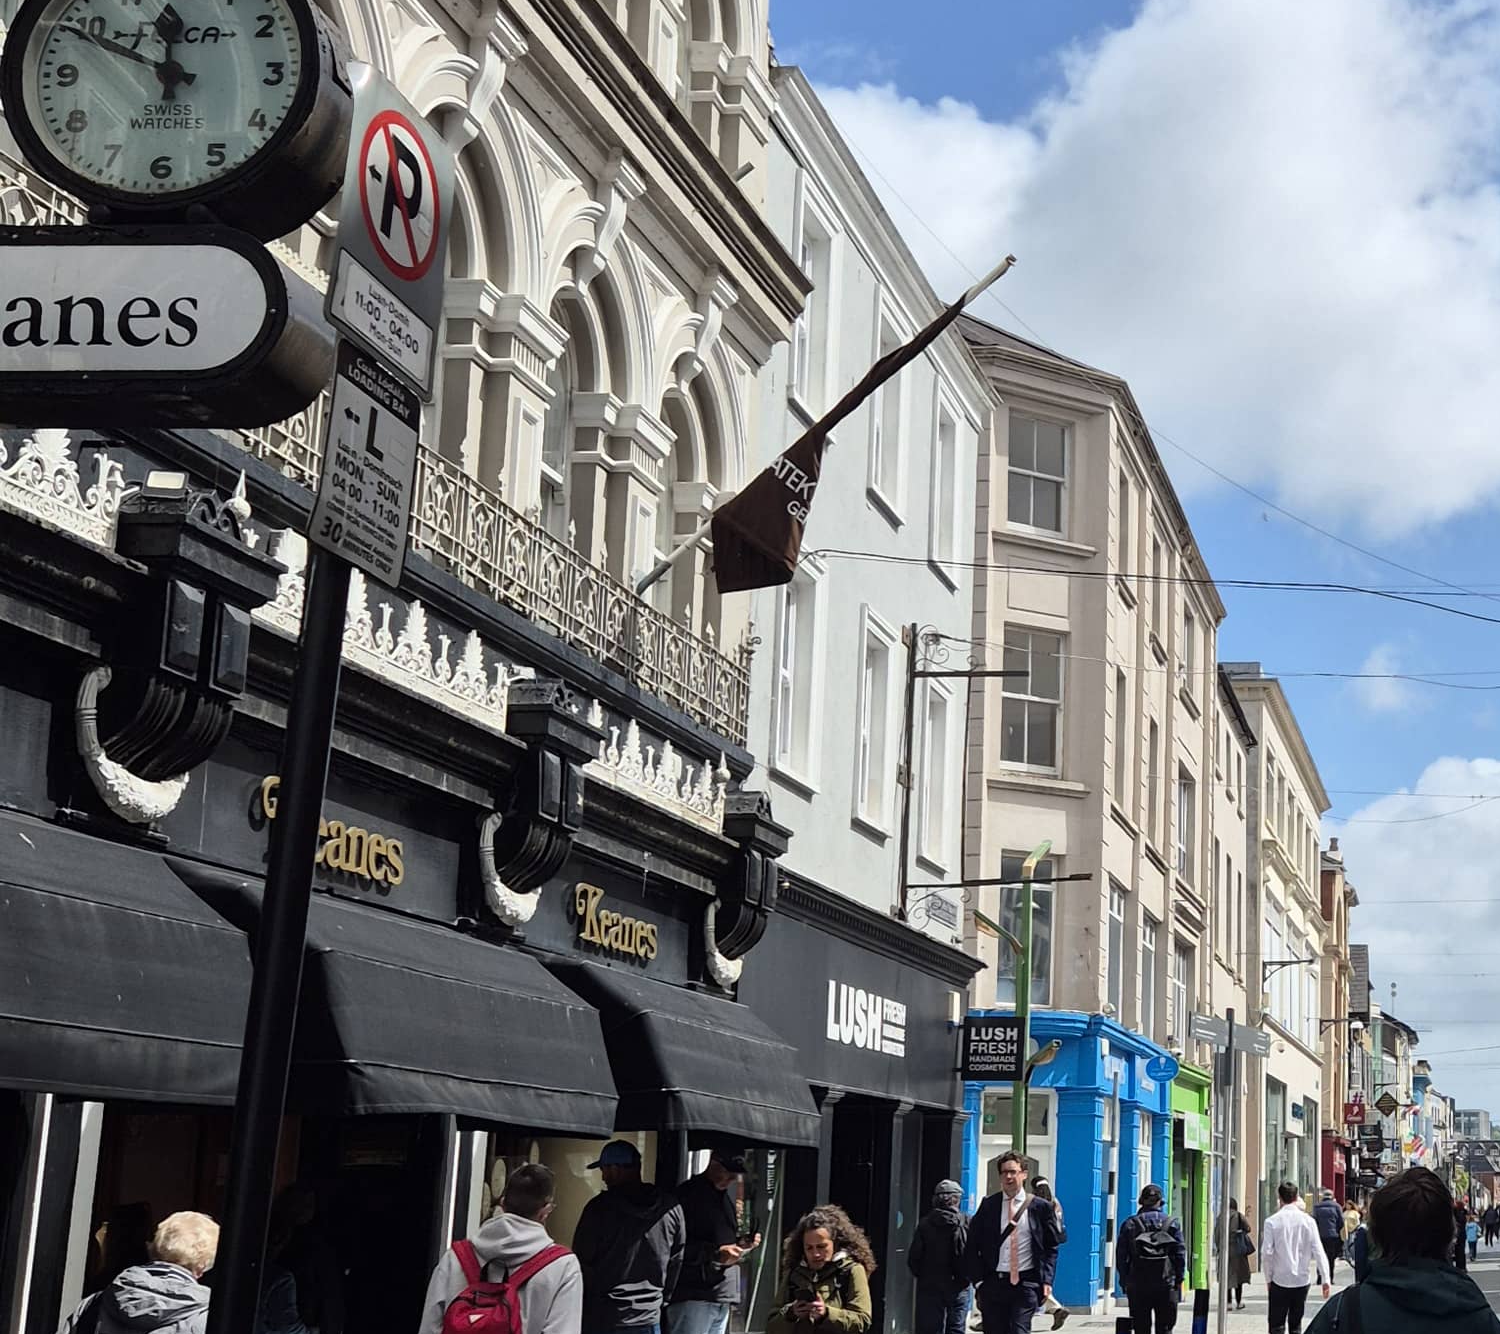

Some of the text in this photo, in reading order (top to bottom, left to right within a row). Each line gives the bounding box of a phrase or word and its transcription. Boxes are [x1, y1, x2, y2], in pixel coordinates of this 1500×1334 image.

[76, 16, 107, 39] 10
[255, 15, 275, 38] 2
[56, 63, 79, 87] 9
[262, 62, 285, 86] 3
[65, 109, 88, 133] 8
[143, 103, 193, 116] SWISS
[248, 108, 267, 131] 4
[130, 117, 204, 130] WATCHES
[103, 144, 123, 168] 7
[206, 143, 227, 167] 5
[149, 156, 172, 179] 6
[2, 295, 199, 347] anes
[355, 291, 381, 321] 11:00
[389, 320, 419, 354] 04:00
[348, 364, 411, 420] LOADING BAY
[366, 406, 384, 462] L
[335, 453, 366, 485] MON.
[377, 478, 401, 509] SUN.
[320, 518, 343, 544] 30
[575, 882, 658, 960] Keanes
[827, 979, 882, 1052] LUSH
[970, 1027, 1018, 1041] LUSH
[969, 1055, 1016, 1063] HANDMADE
[970, 1042, 1017, 1054] FRESH
[969, 1063, 1016, 1071] COSMETICS
